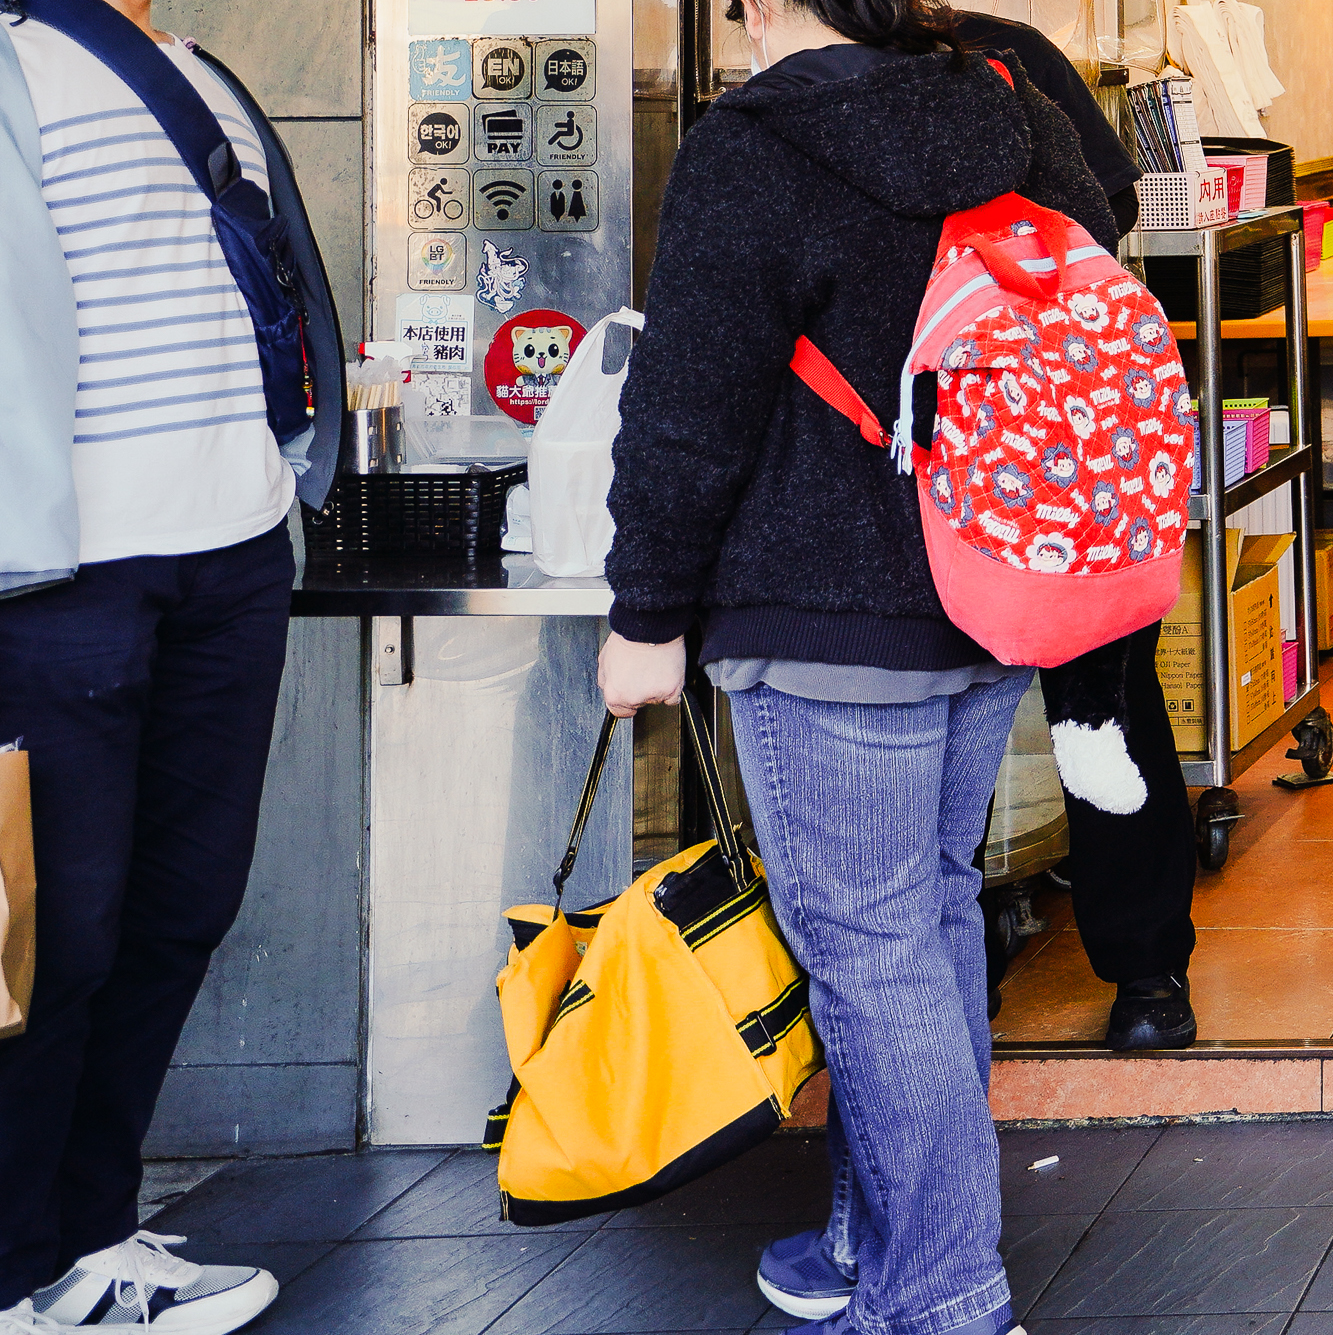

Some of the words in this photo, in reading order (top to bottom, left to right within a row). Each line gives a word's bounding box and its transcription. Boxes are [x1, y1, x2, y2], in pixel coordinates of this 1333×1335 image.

[487, 58, 520, 76] EN
[547, 59, 585, 76] 日本語
[560, 77, 578, 86] OK!
[421, 89, 461, 97] FRIENDLY
[420, 124, 460, 141] 한국어
[435, 140, 452, 149] OK!
[487, 142, 522, 154] PAY
[1199, 177, 1225, 203] 內用
[429, 245, 445, 254] LG
[429, 253, 446, 262] BT
[1107, 281, 1142, 301] Milky
[1038, 308, 1070, 327] Milky
[403, 325, 466, 343] 本店使用
[433, 344, 466, 362] 豬肉
[1153, 360, 1185, 382] Milky
[1089, 386, 1121, 405] Milky
[1137, 417, 1164, 436] Milky
[1000, 429, 1038, 460] Milky
[1035, 503, 1081, 529] Milky
[1155, 509, 1182, 531] Milky
[1086, 543, 1122, 564] Milky
[1172, 661, 1191, 669] Paper
[1160, 671, 1184, 680] Nippon
